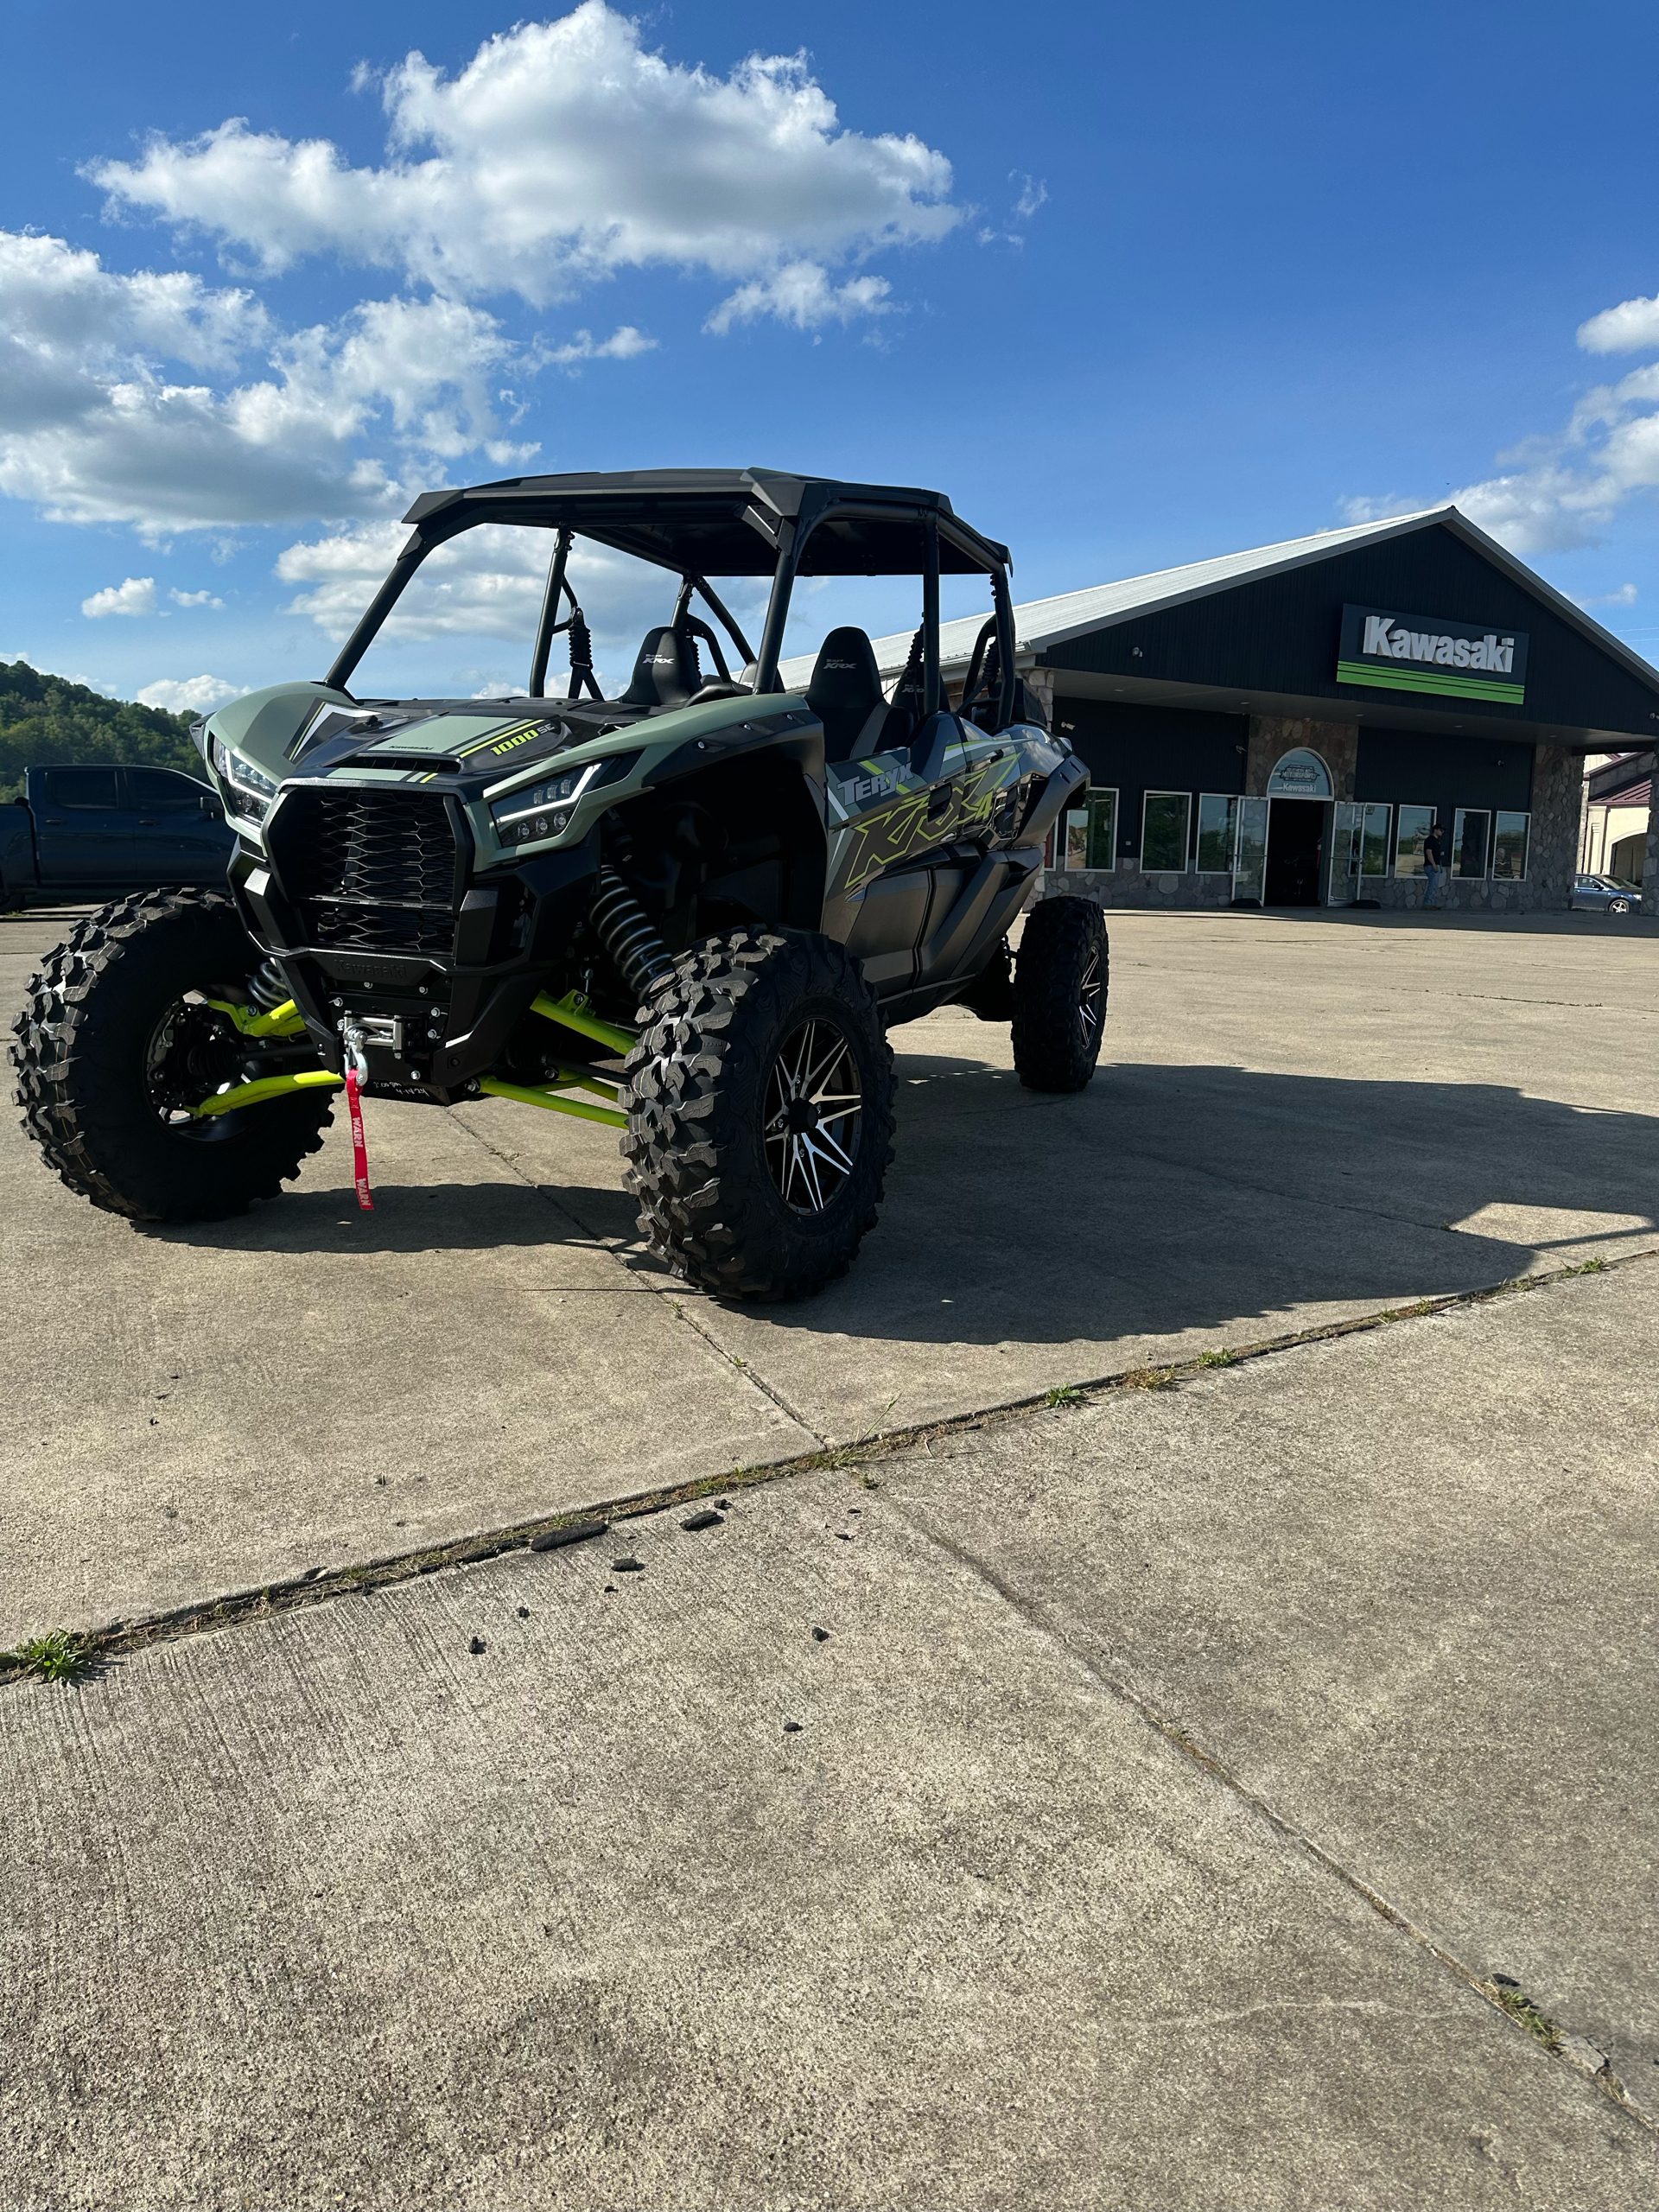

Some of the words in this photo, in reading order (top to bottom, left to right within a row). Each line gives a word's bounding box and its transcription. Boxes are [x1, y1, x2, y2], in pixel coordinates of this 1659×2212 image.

[1363, 615, 1514, 673] Kawasaki
[490, 729, 539, 756] 1000
[537, 723, 555, 734] SE
[837, 762, 913, 806] TERYX
[1282, 783, 1316, 793] Kawasaki
[334, 959, 407, 980] Kawasaki
[353, 1116, 363, 1147] WARN
[356, 1178, 372, 1206] WARN
